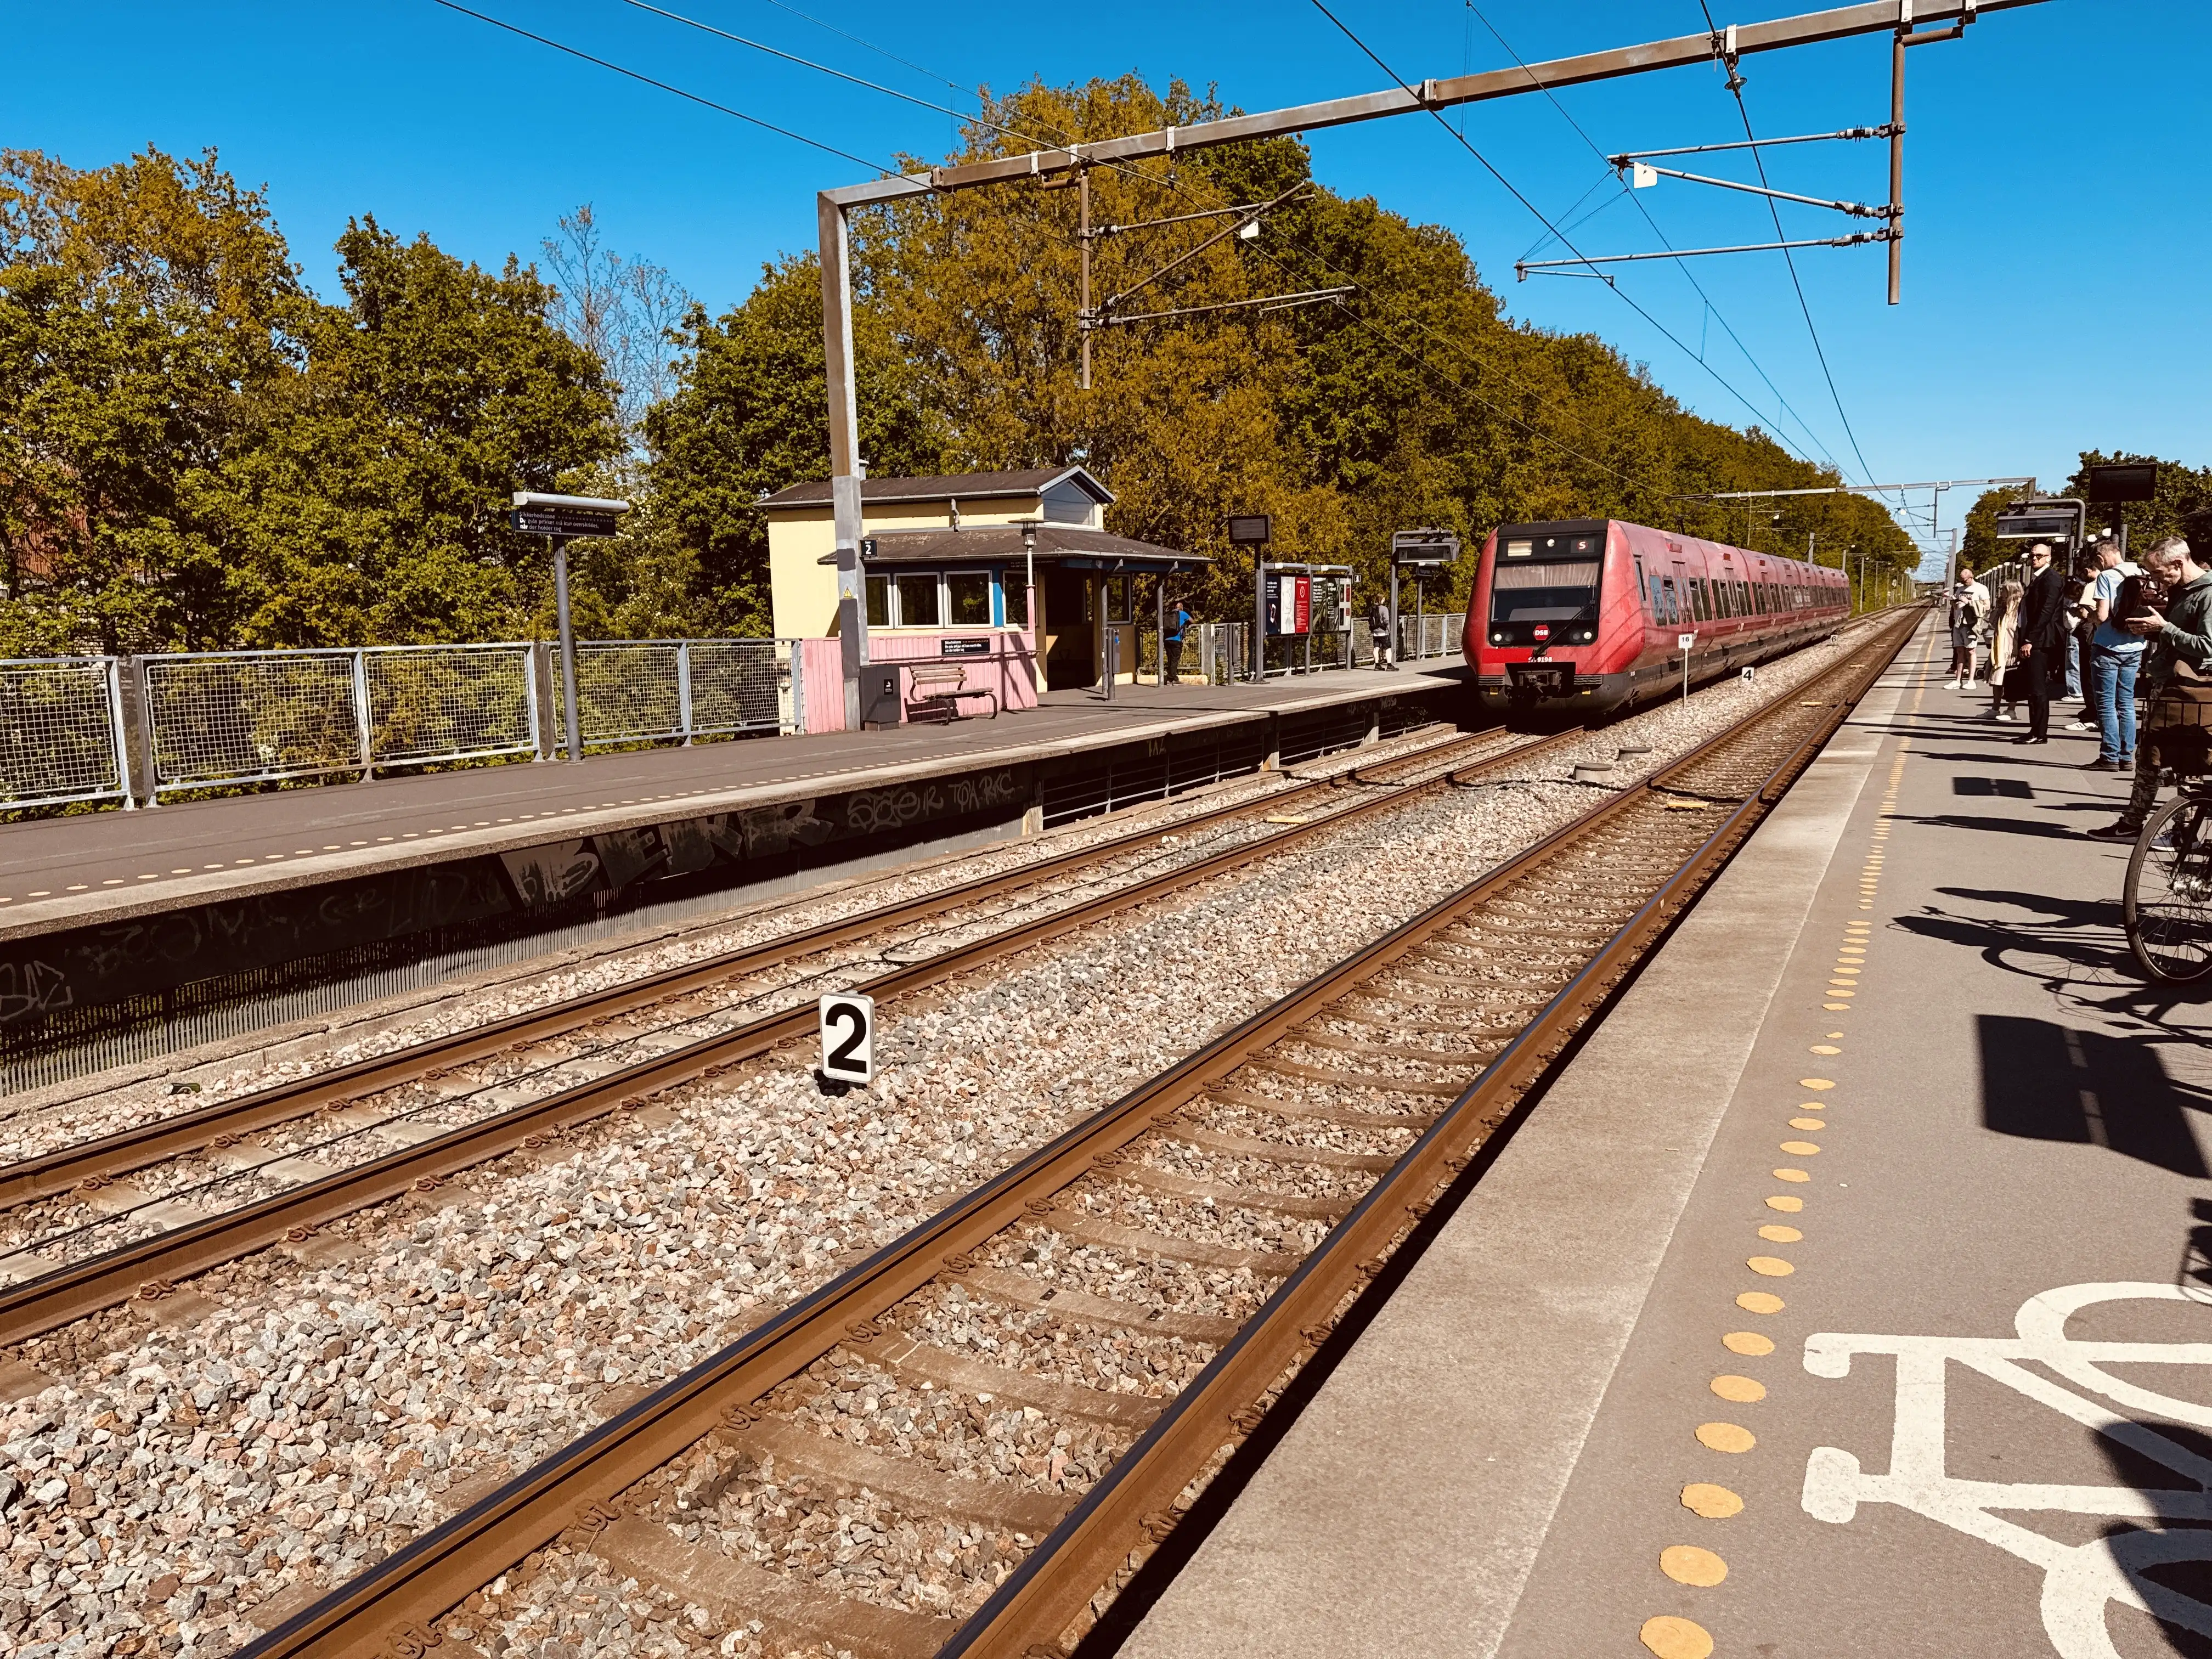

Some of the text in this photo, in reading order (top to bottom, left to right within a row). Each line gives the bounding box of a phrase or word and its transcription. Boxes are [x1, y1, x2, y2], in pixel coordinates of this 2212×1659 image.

[865, 544, 872, 555] 2
[1579, 541, 1586, 549] S
[1743, 669, 1752, 681] 4
[825, 1002, 867, 1074] 2
